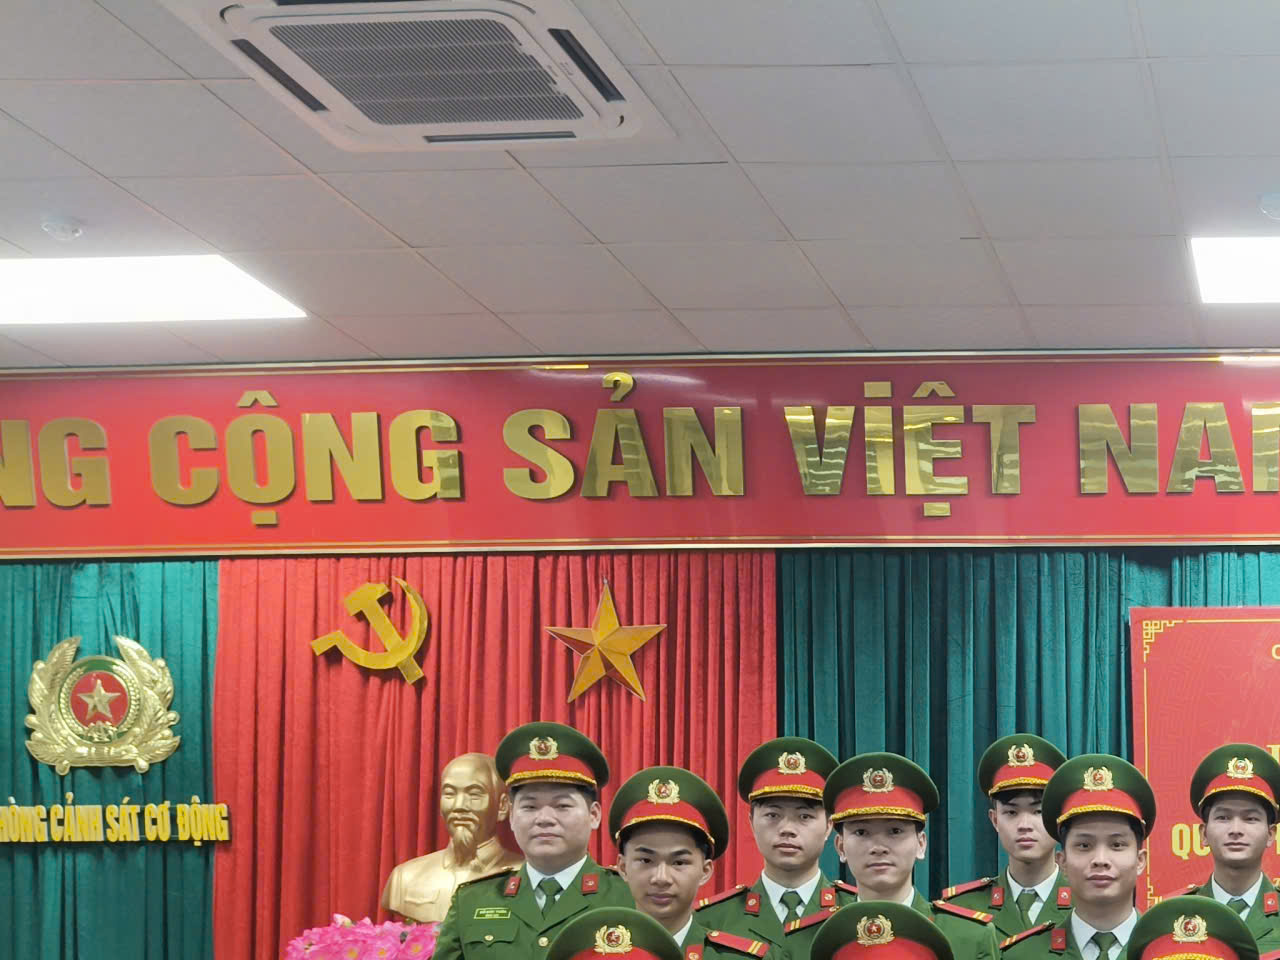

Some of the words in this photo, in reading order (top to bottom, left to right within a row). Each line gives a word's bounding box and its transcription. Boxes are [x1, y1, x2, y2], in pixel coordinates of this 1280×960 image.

[148, 390, 462, 526] CỘNG
[503, 372, 744, 498] SẢN
[49, 792, 104, 842] CẢNH
[106, 796, 140, 842] SÁT
[144, 800, 170, 842] CƠ
[177, 795, 229, 846] ĐỘNG
